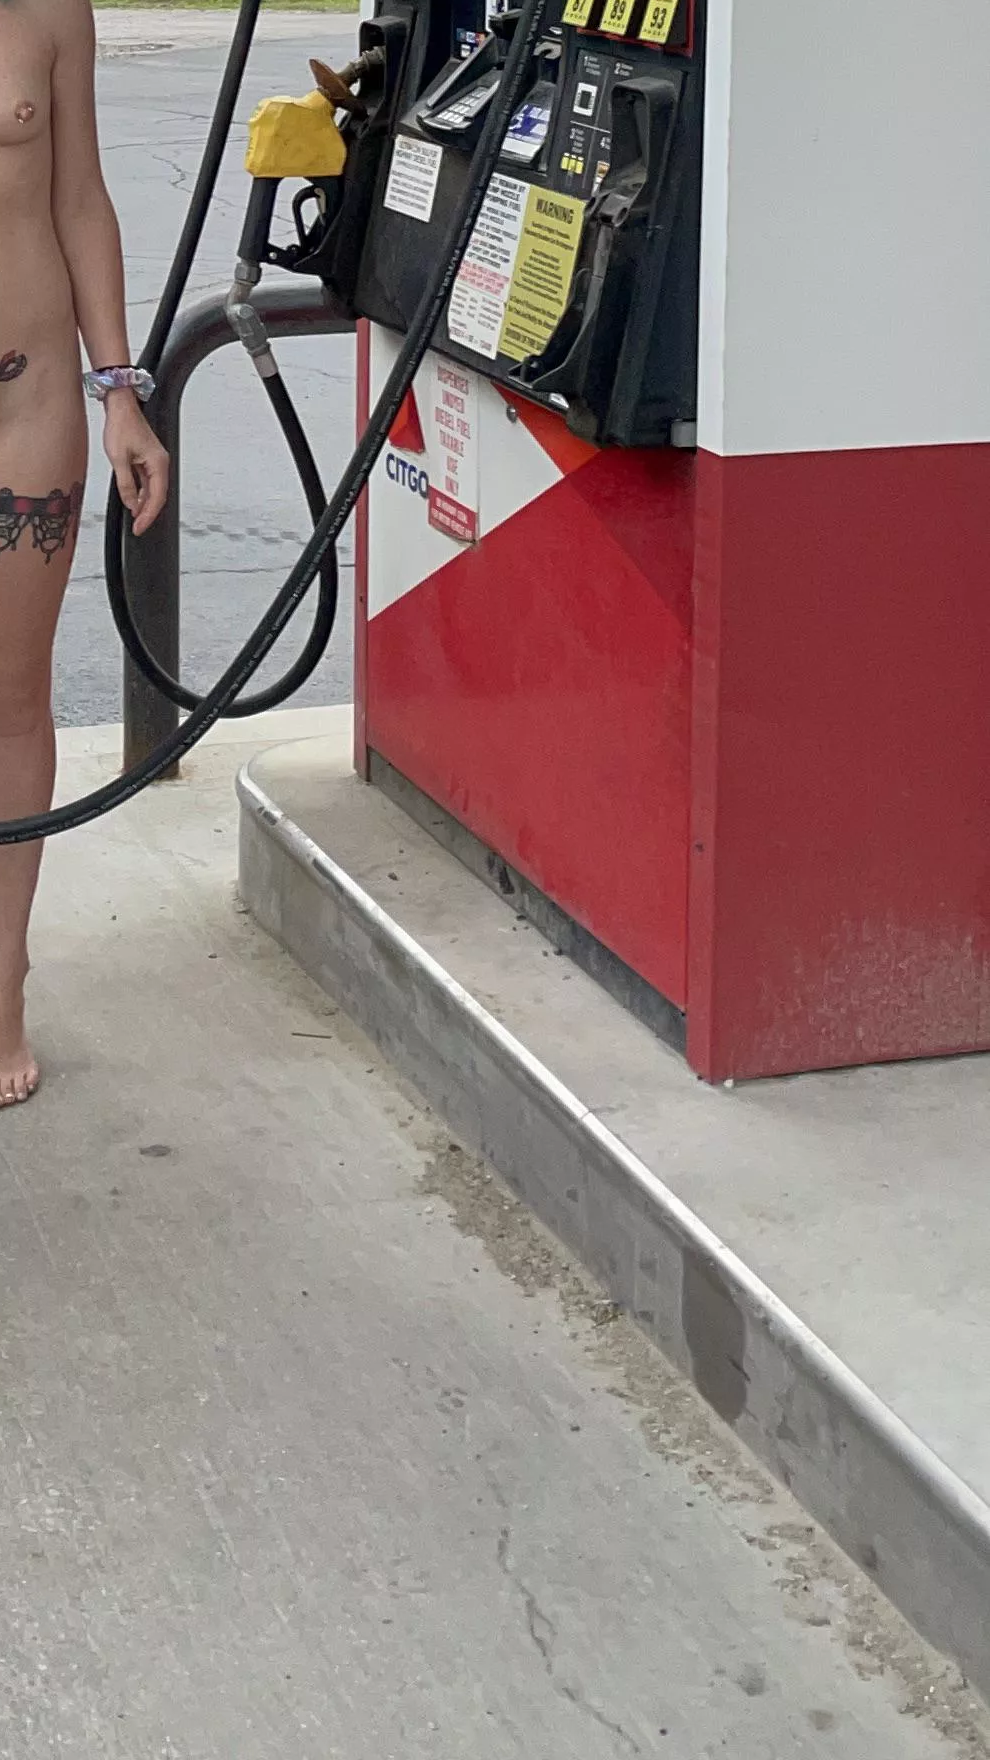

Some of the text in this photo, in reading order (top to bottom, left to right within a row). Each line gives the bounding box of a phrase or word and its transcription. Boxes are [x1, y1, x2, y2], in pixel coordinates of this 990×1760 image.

[610, 0, 627, 21] 89
[650, 7, 667, 29] 93
[536, 198, 574, 225] WARNING
[386, 452, 429, 499] CITGO
